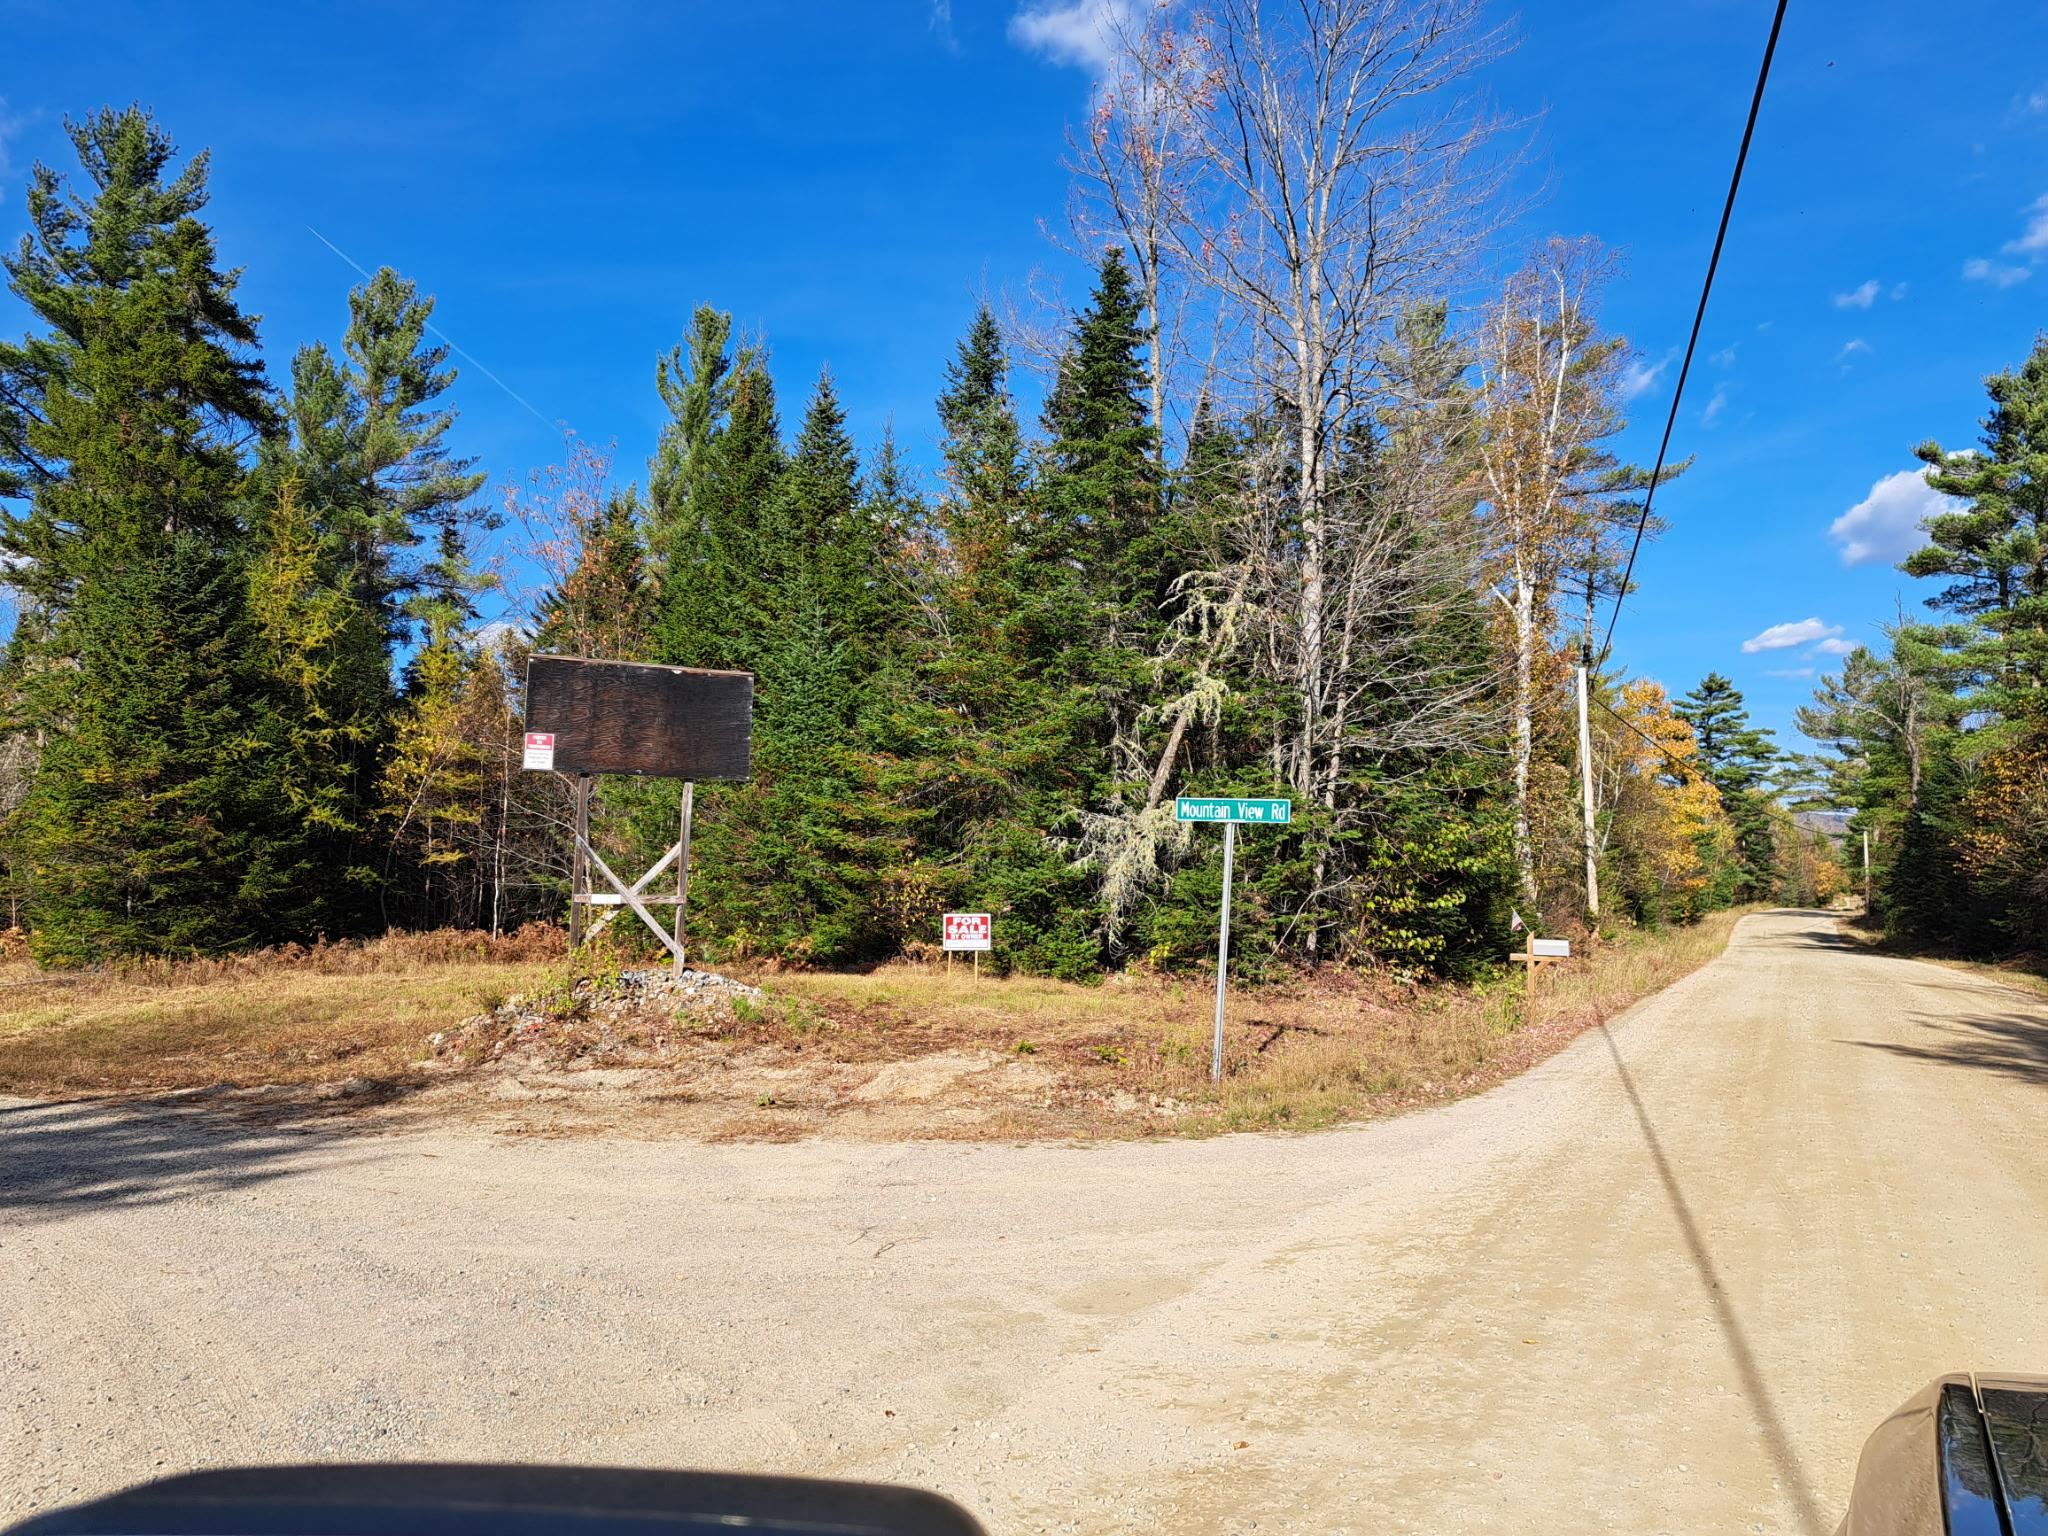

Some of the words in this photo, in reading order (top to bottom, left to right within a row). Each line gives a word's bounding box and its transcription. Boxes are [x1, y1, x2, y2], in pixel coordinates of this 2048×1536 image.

[1180, 801, 1231, 818] Mountain
[1237, 802, 1264, 819] View
[1271, 803, 1286, 820] Rd
[953, 917, 981, 925] FOR
[947, 925, 987, 934] SALE
